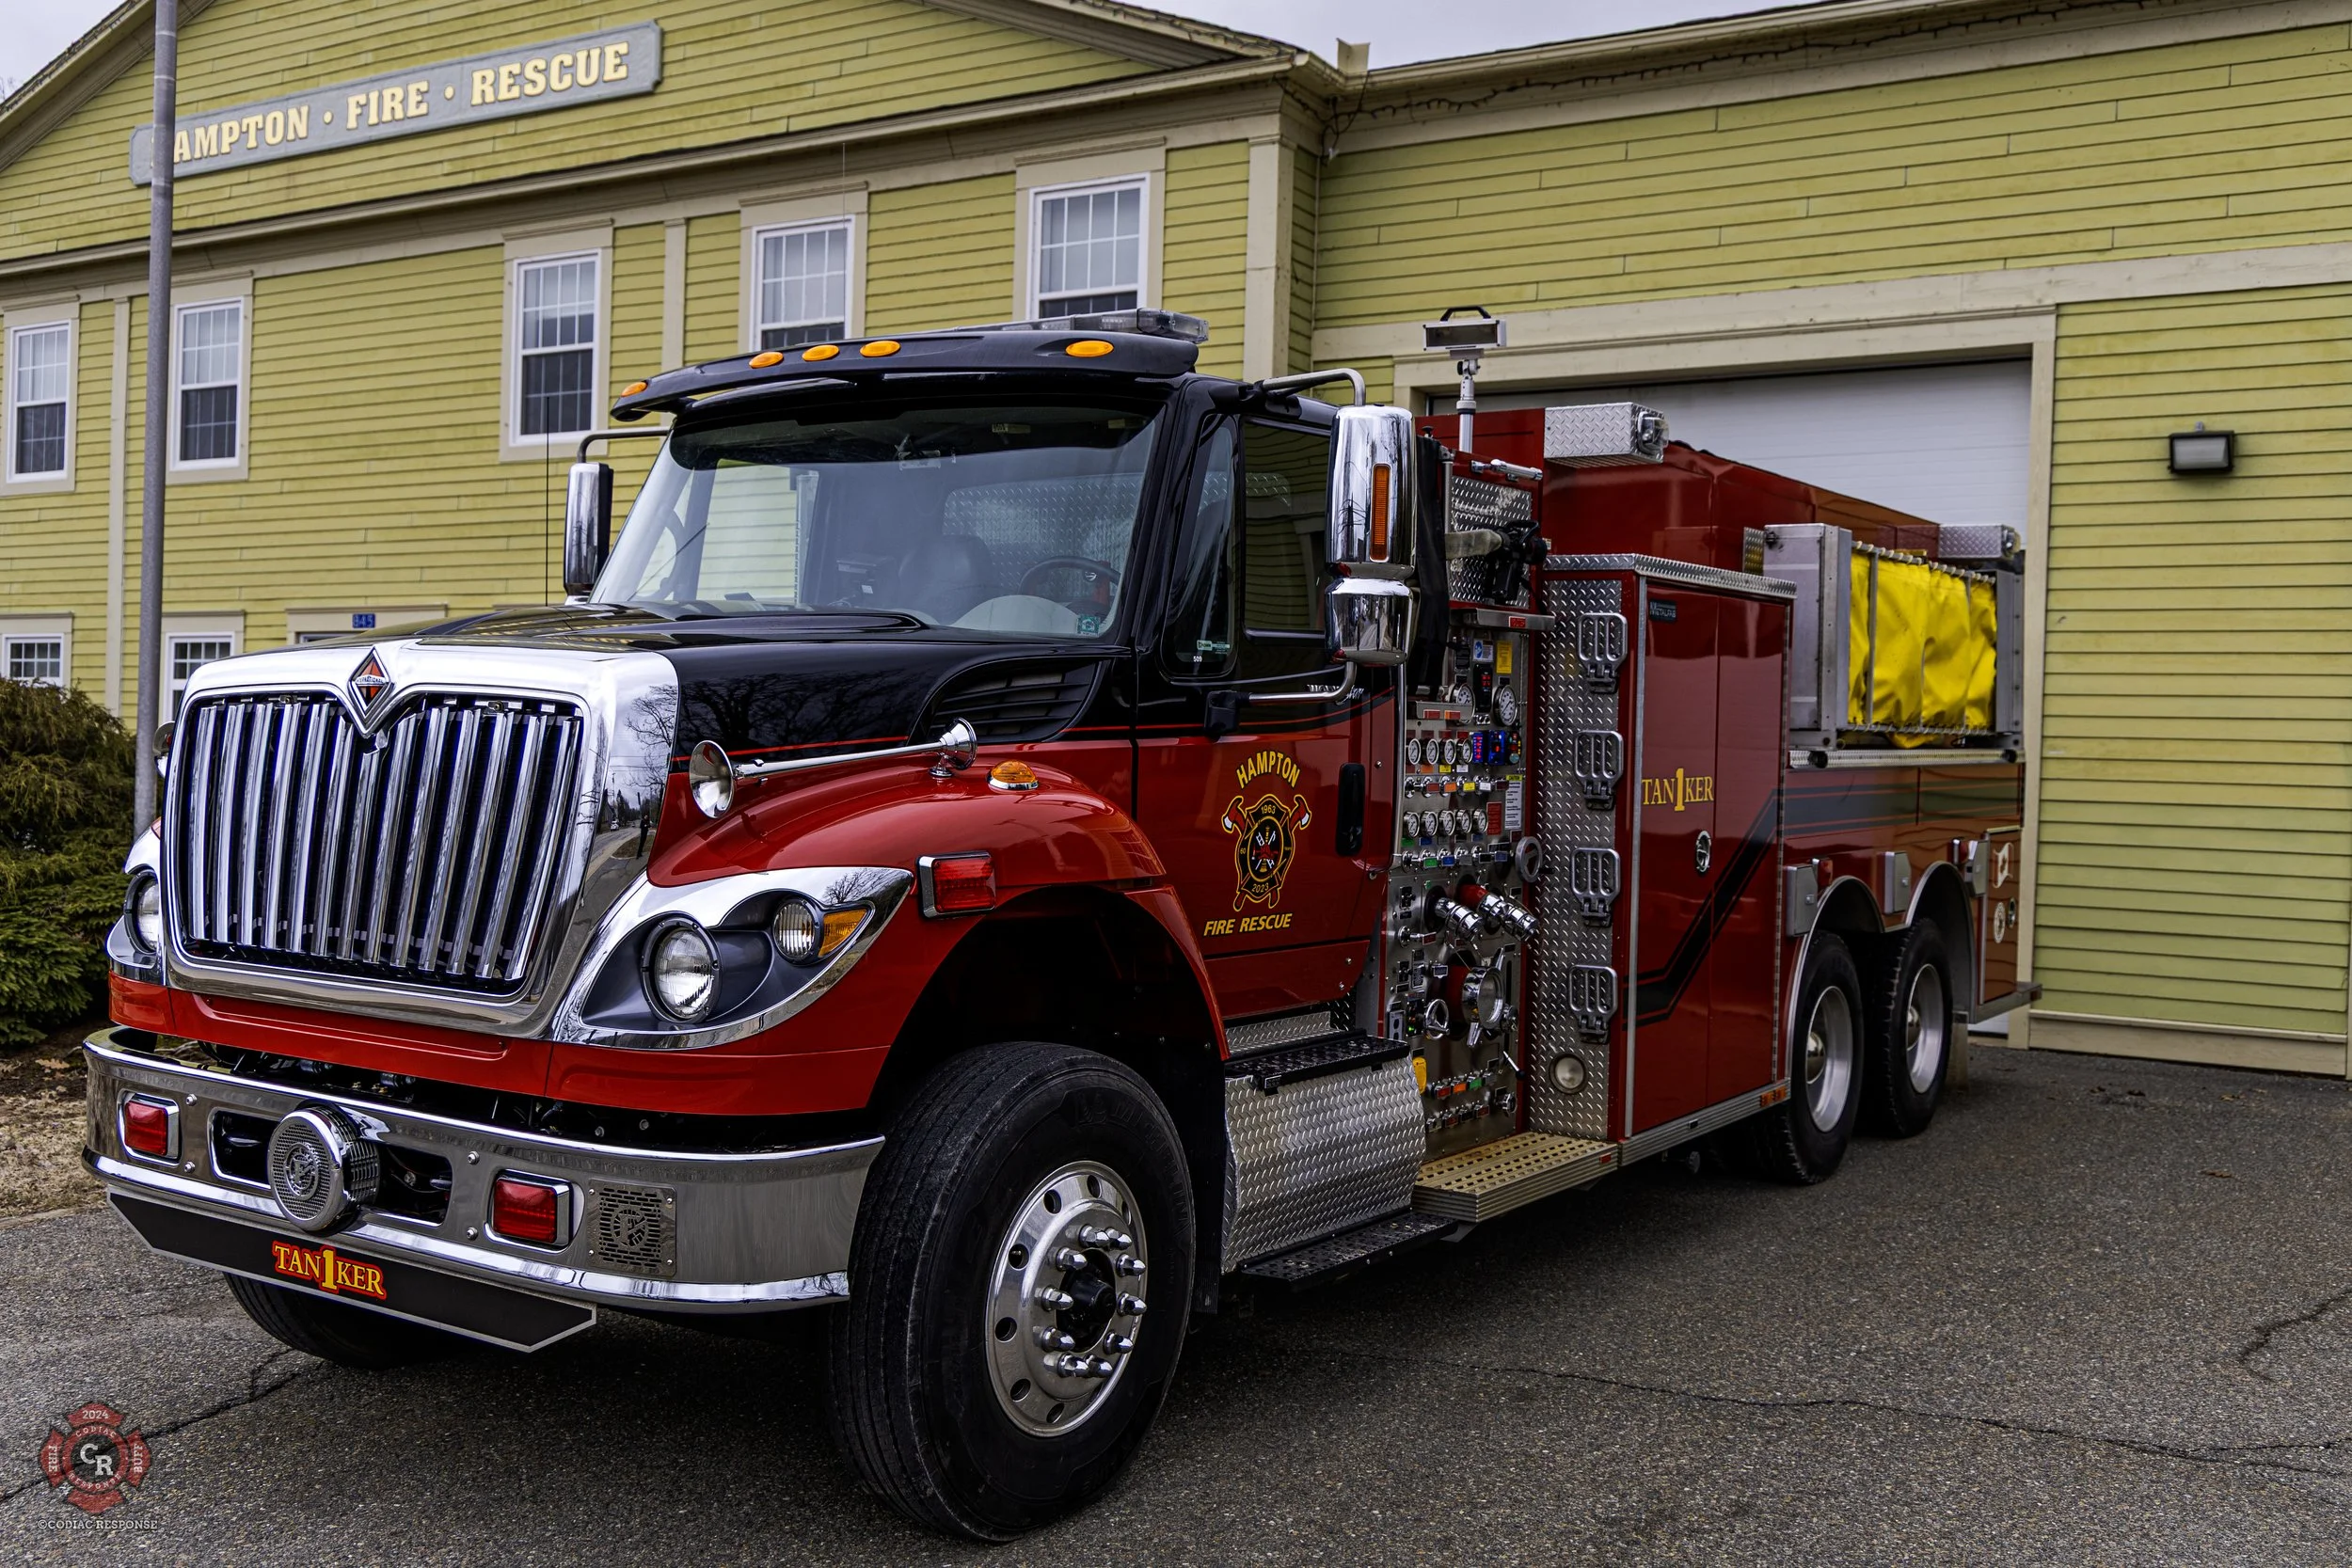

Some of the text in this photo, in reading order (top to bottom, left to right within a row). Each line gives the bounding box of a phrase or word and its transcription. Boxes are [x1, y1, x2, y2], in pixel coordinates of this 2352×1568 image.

[151, 41, 629, 167] AMPTON FIRE RESCUE
[1236, 751, 1301, 789] HAMPTON
[1261, 804, 1276, 815] 1963
[1251, 883, 1269, 894] 2023
[1203, 913, 1293, 937] FIRE RESCUE
